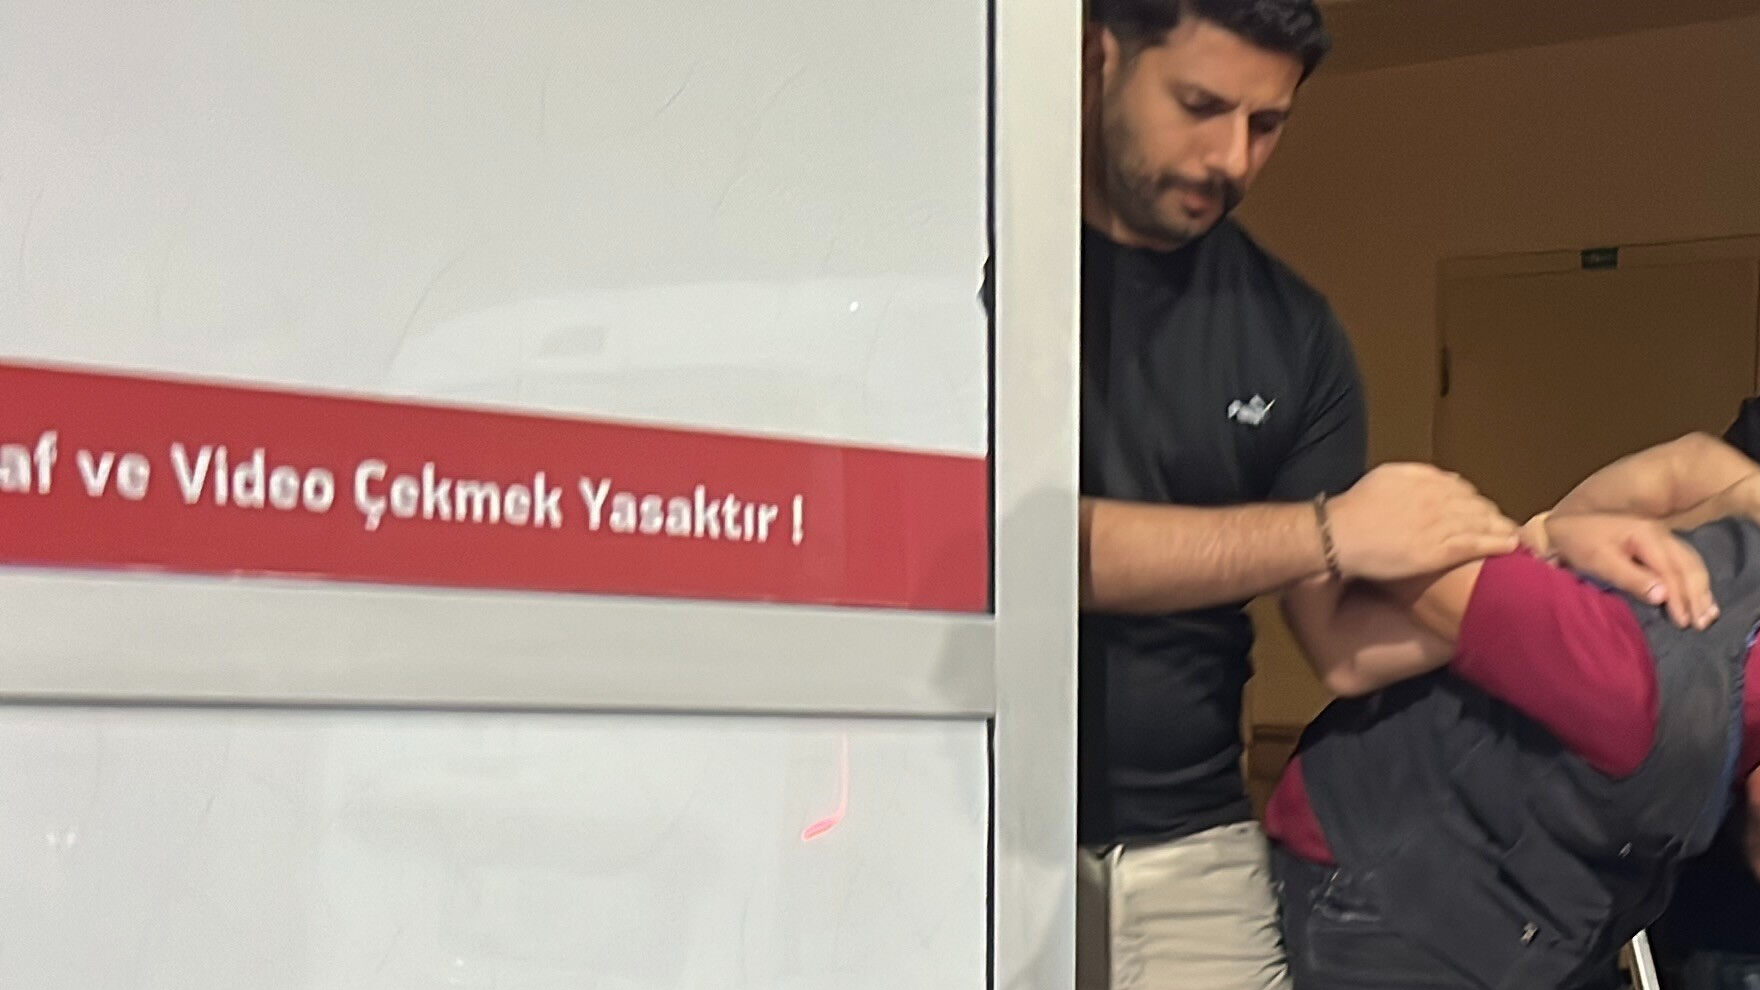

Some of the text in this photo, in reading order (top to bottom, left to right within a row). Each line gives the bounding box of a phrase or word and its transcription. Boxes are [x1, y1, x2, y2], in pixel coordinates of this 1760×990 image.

[0, 431, 58, 494] af
[76, 449, 151, 500] ve
[170, 441, 335, 513] Video
[354, 458, 563, 531] Çekmek
[578, 476, 779, 543] Yasaktır
